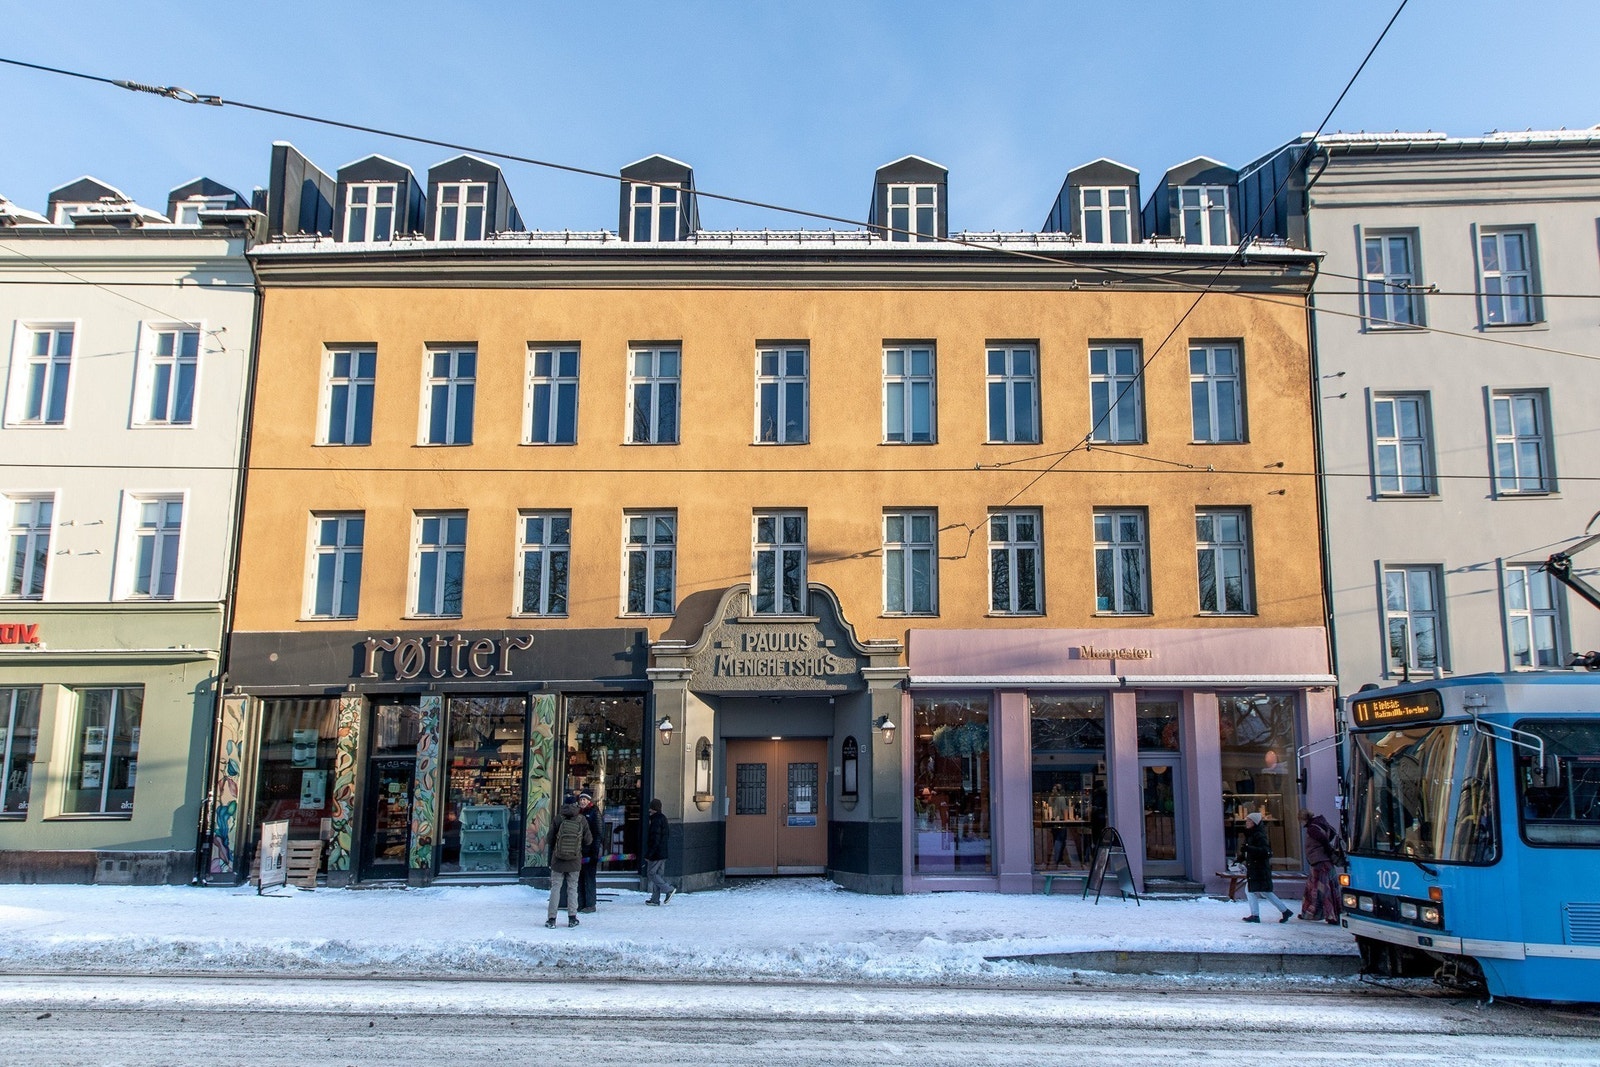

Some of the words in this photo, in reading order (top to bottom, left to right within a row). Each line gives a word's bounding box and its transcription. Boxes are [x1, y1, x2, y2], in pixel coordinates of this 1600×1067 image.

[745, 632, 812, 652] PAULUS
[360, 633, 535, 681] røtter
[717, 653, 840, 677] MENIGHETSHUS
[1358, 703, 1369, 721] 11
[1376, 869, 1401, 890] 102
